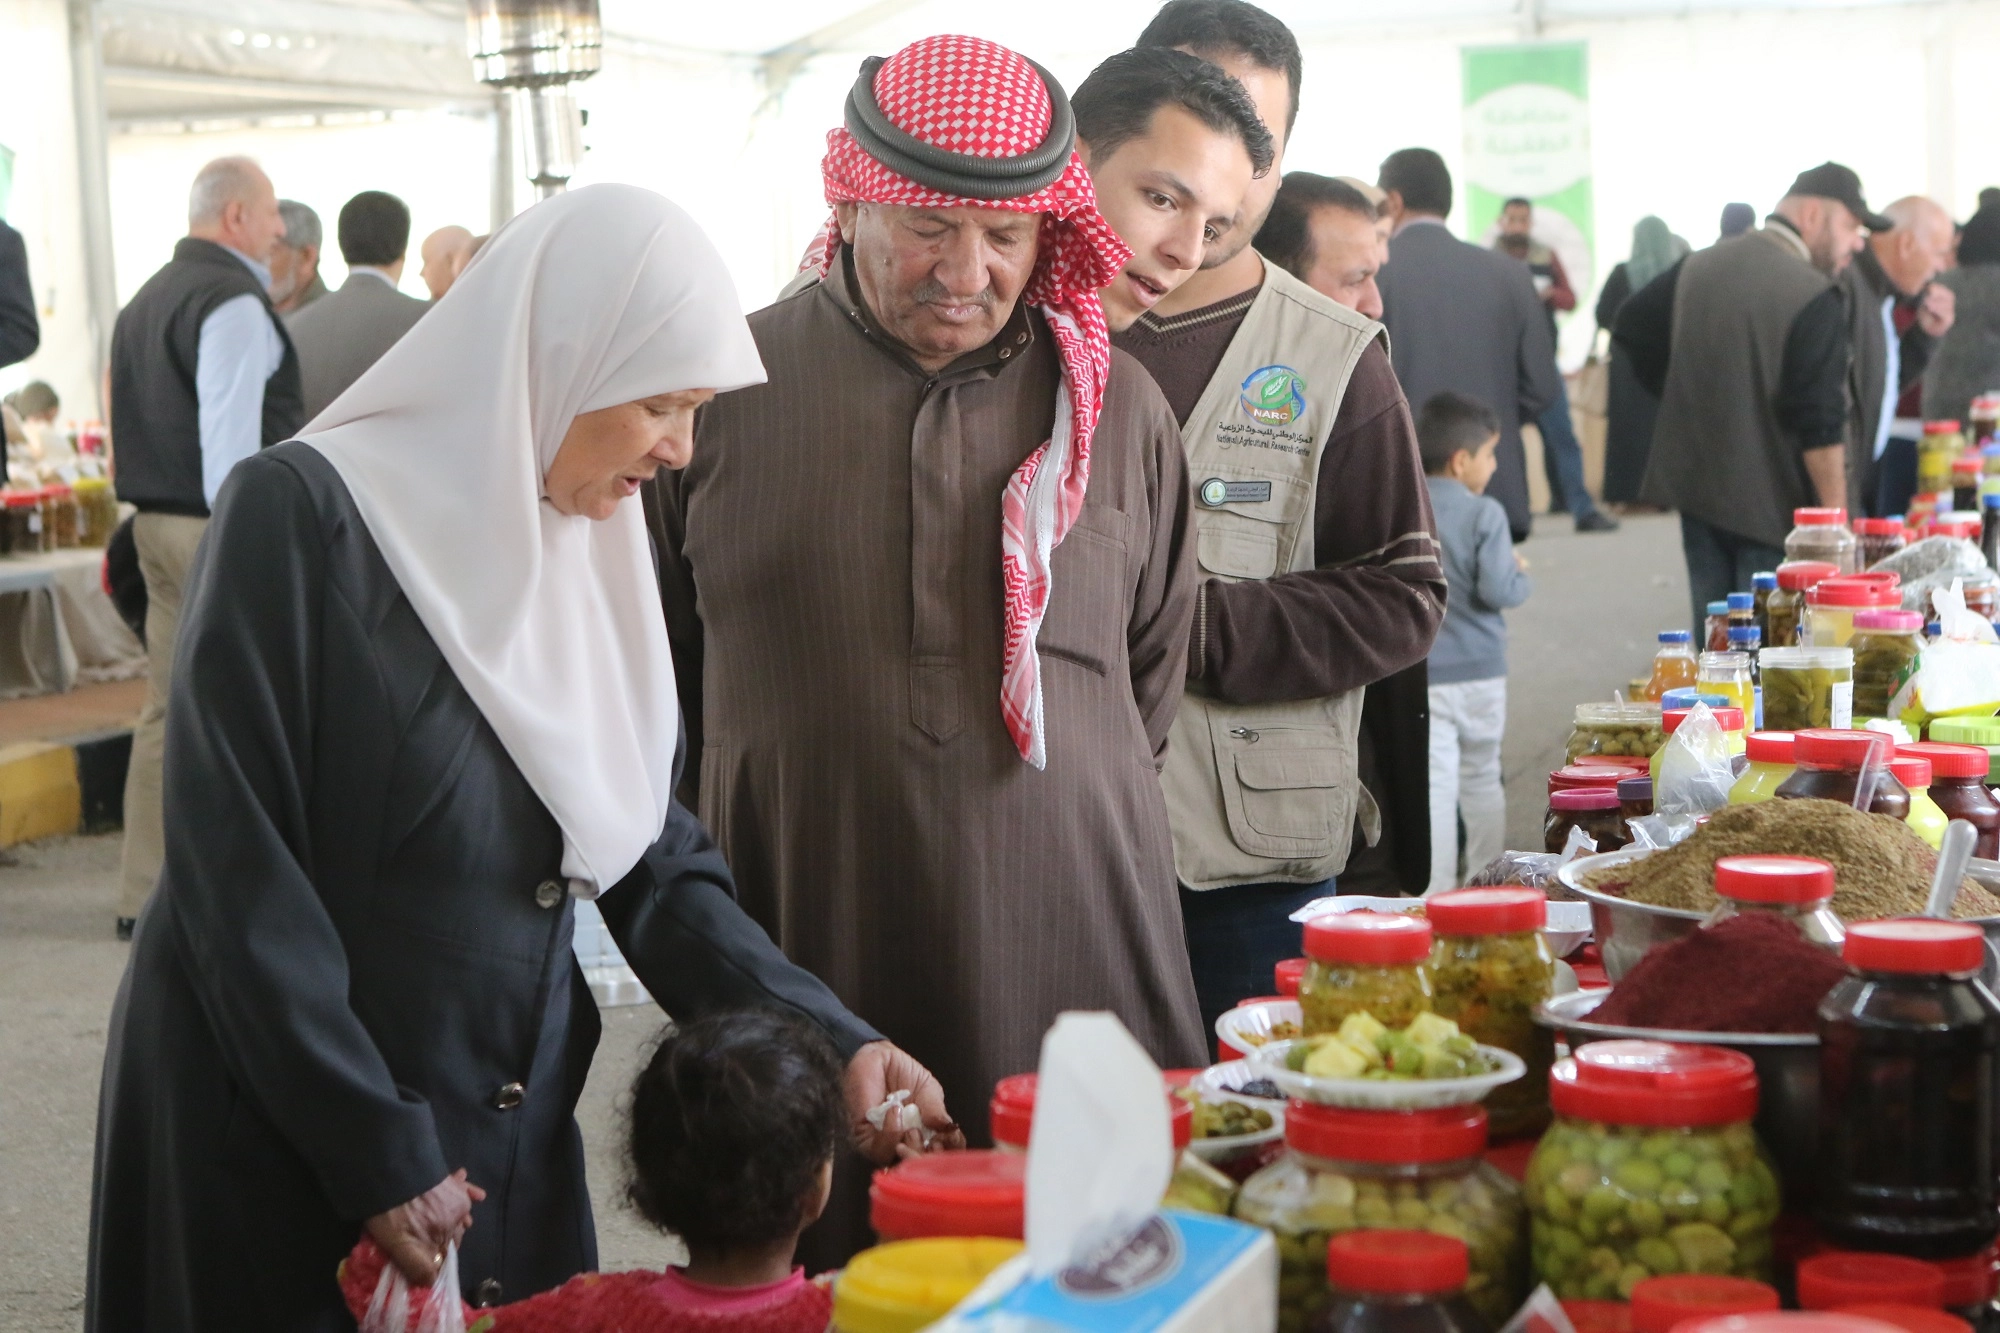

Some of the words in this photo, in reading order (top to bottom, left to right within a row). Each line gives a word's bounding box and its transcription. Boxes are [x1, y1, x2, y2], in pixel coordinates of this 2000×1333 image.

[1254, 409, 1288, 420] NARC
[1219, 421, 1244, 433] الزراعية
[1245, 425, 1272, 437] للبحوث
[1272, 430, 1296, 440] الوطني
[1294, 434, 1313, 443] المركز
[1216, 433, 1238, 444] National
[1238, 435, 1269, 448] Agricultural
[1271, 441, 1293, 453] Research
[1294, 446, 1311, 457] Center
